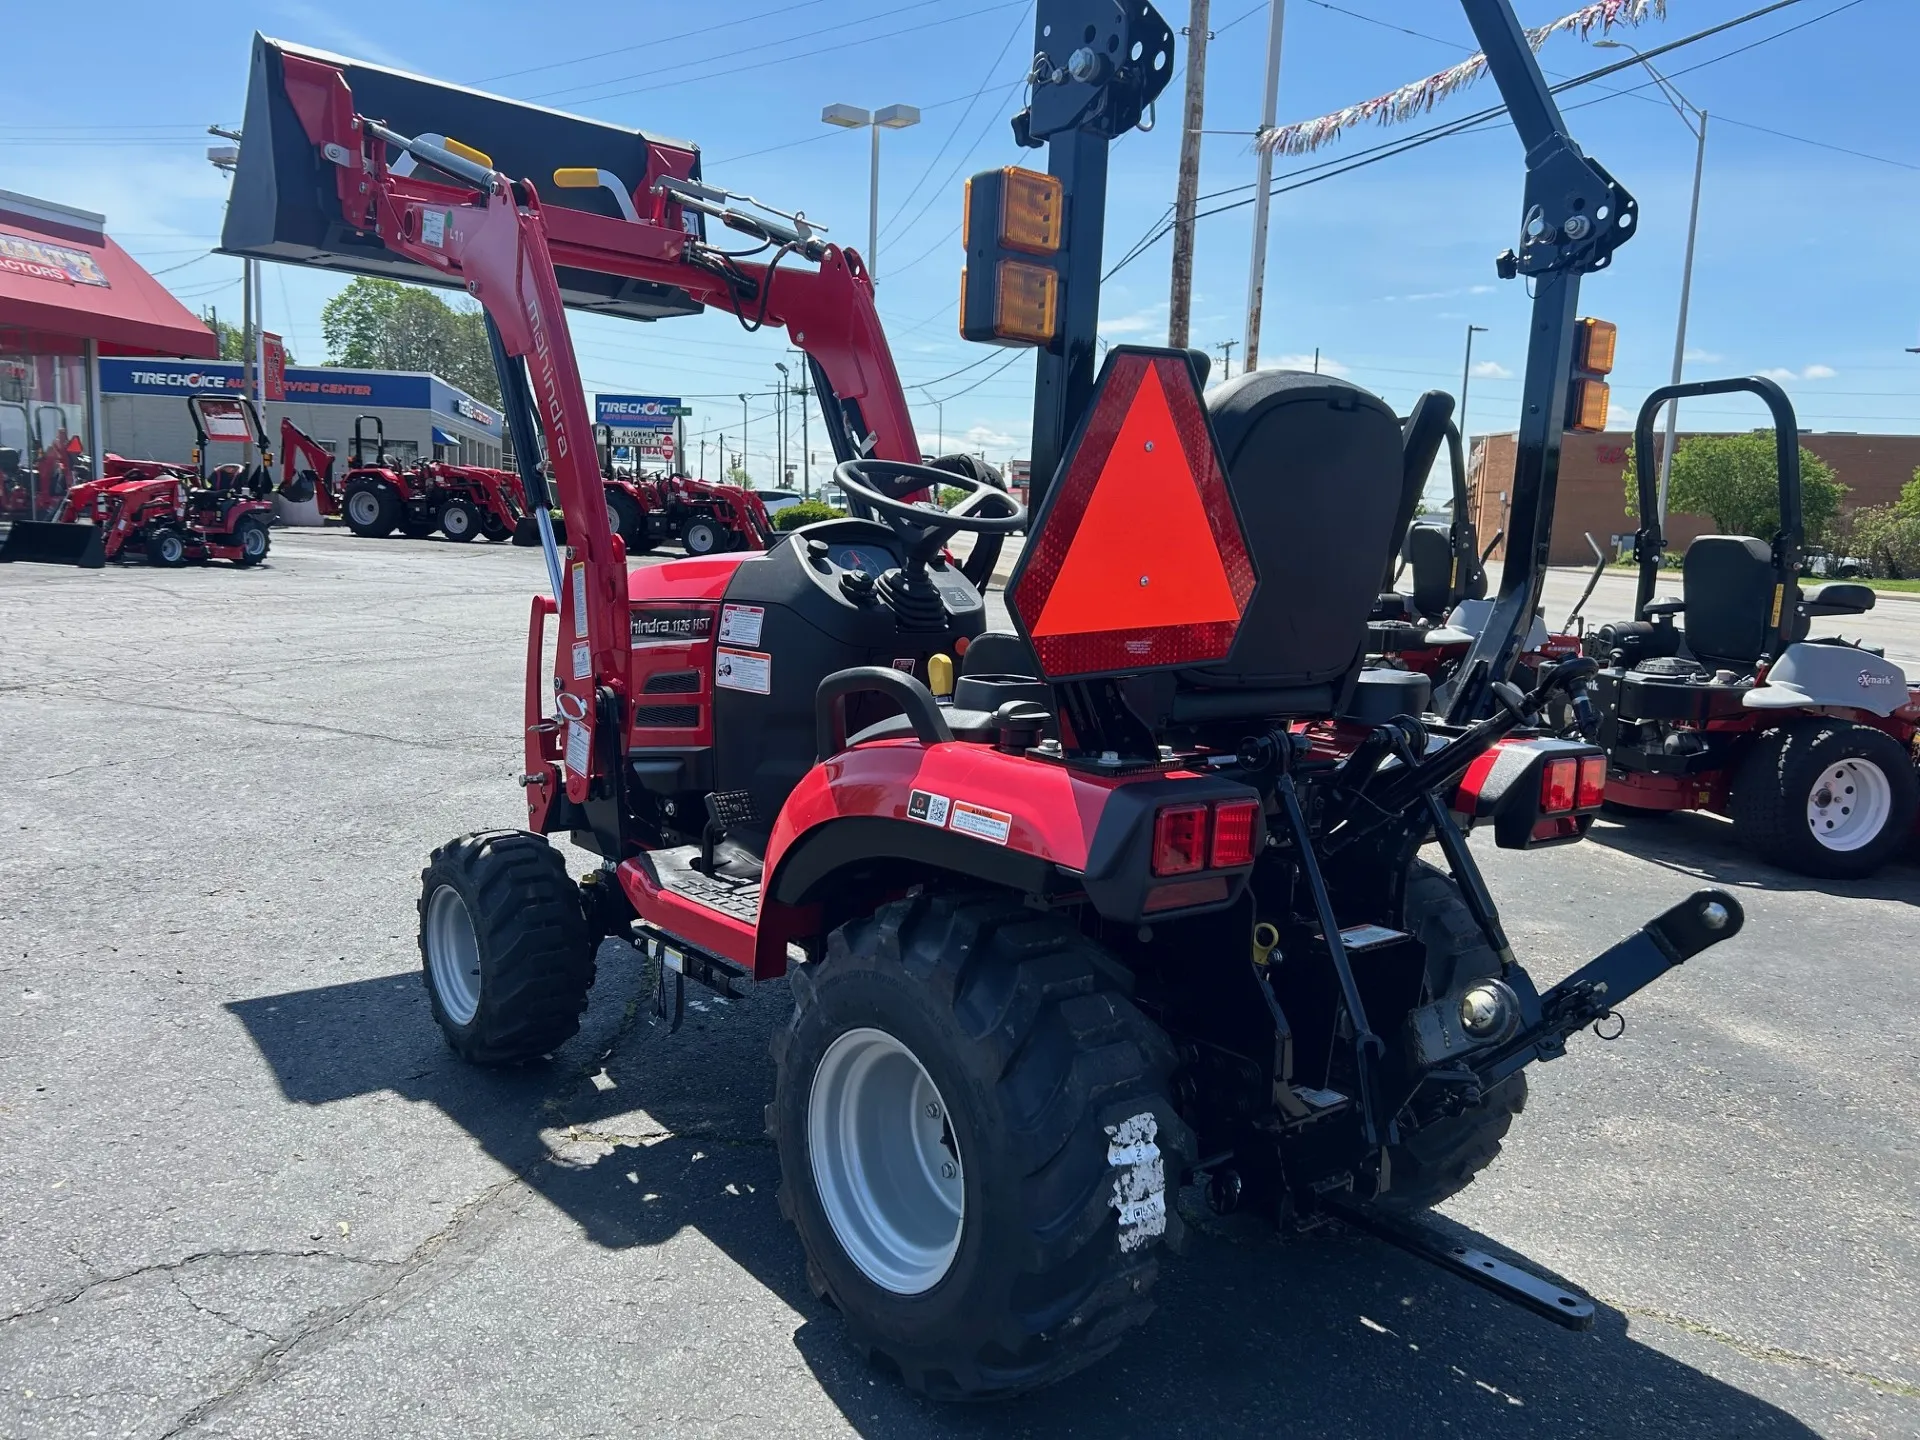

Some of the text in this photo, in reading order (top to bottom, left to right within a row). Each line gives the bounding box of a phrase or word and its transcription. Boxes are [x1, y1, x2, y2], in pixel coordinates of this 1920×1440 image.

[527, 299, 569, 459] mahindra
[321, 383, 371, 396] CENTER
[672, 619, 692, 631] 1126
[693, 617, 711, 630] HST
